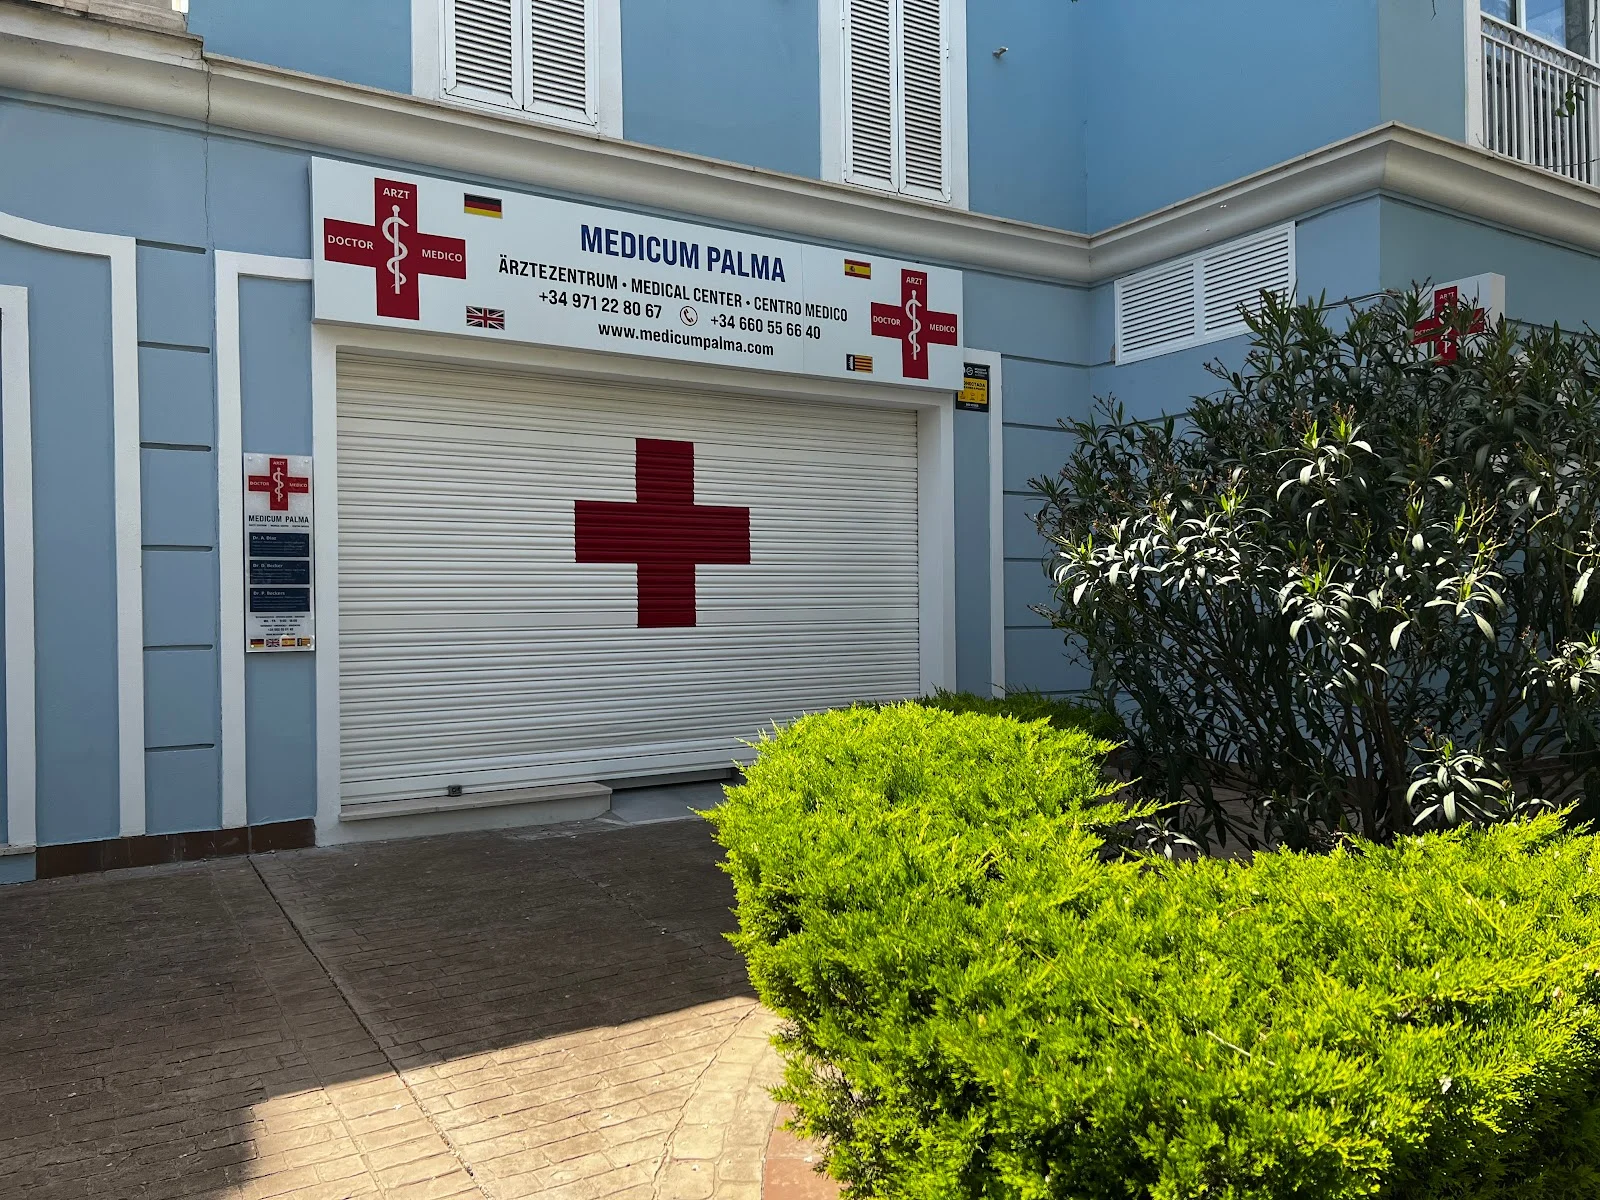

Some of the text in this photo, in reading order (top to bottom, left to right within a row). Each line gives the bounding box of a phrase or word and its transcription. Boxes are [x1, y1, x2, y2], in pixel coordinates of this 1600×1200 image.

[383, 187, 410, 200] ARZT
[327, 234, 374, 250] DOCTOR
[421, 248, 463, 263] MEDICO
[580, 224, 786, 283] MEDICUM PALMA
[498, 254, 848, 323] ÄRZTEZENTRUM MEDICAL CENTER CENTRO MEDICO
[906, 276, 923, 286] ARZT
[538, 289, 662, 319] +34 971 22 80 67
[710, 313, 821, 340] +34 660 55 66 40
[873, 315, 901, 326] DOCTOR
[929, 323, 956, 334] MEDICO
[598, 323, 774, 356] www.medicumpalma.com
